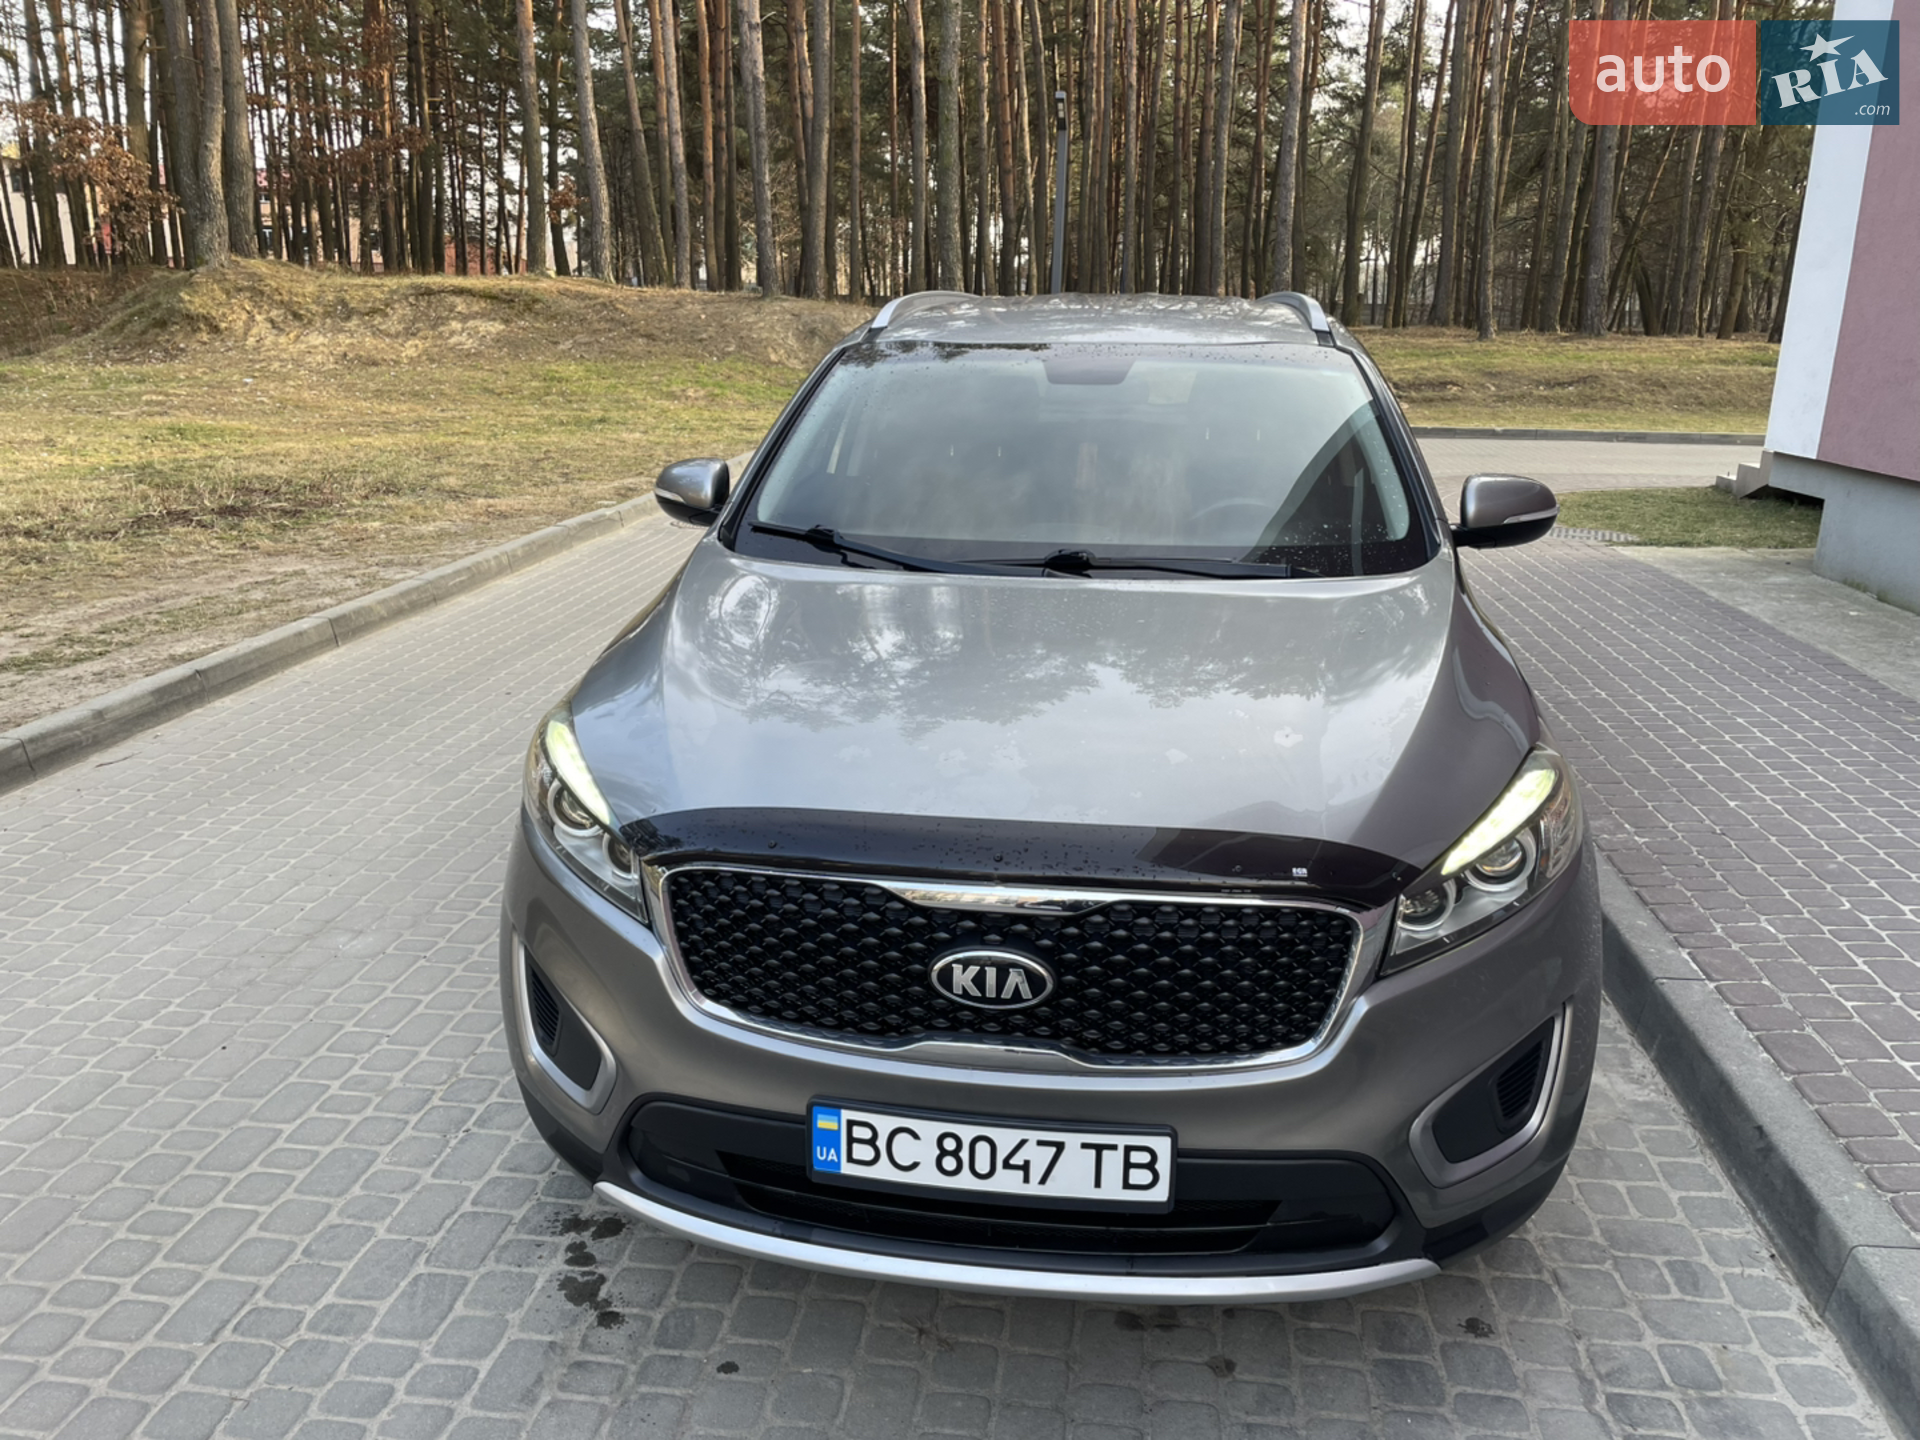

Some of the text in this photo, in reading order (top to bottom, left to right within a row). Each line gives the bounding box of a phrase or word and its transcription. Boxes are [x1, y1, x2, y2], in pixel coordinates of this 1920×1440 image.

[952, 963, 1033, 999] KIA
[816, 1146, 839, 1163] UA
[845, 1118, 1161, 1191] BC 8047 TB
